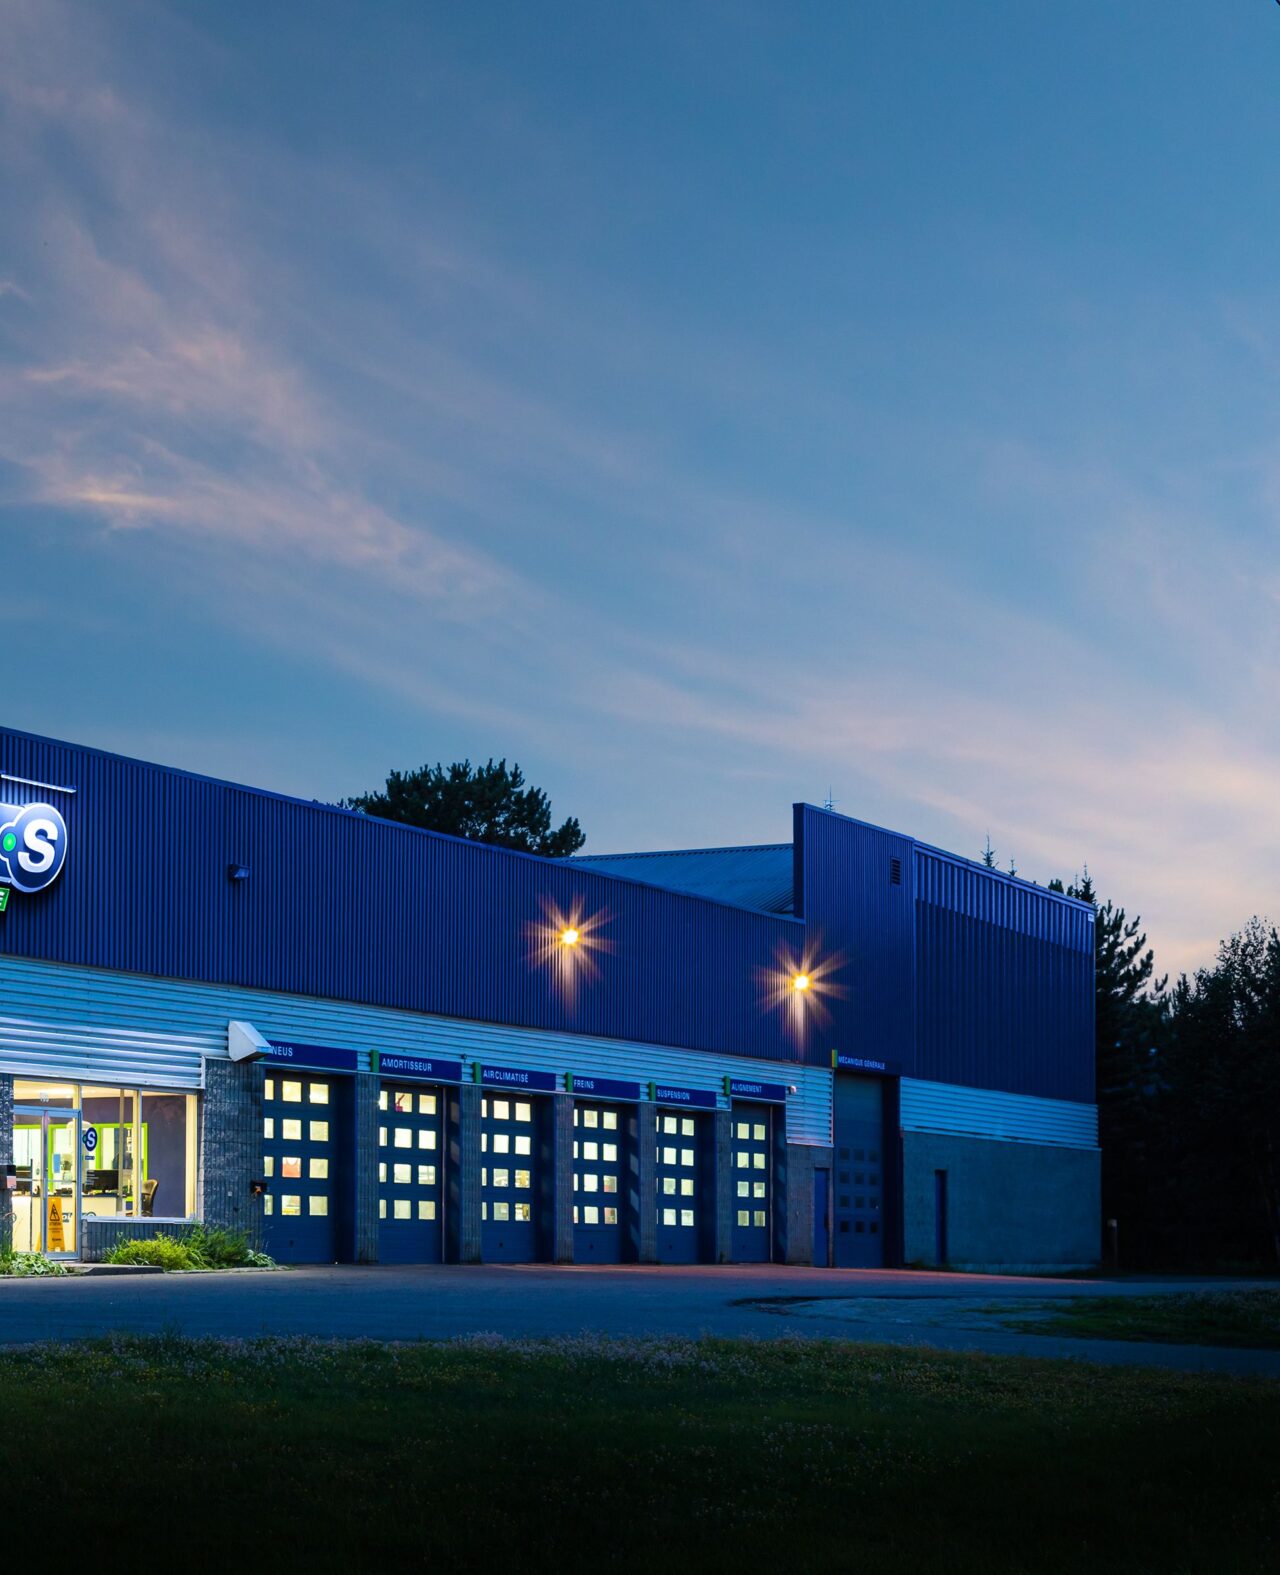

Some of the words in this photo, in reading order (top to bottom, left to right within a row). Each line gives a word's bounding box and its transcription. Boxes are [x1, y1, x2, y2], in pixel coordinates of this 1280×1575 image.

[17, 818, 59, 873] S
[271, 1045, 294, 1057] NEUS
[381, 1058, 433, 1073] AMORTISSEUR
[573, 1079, 595, 1090] FREINS
[731, 1082, 762, 1093] ALIGNEMENT
[657, 1089, 690, 1101] SUSPENSION
[86, 1131, 96, 1148] S
